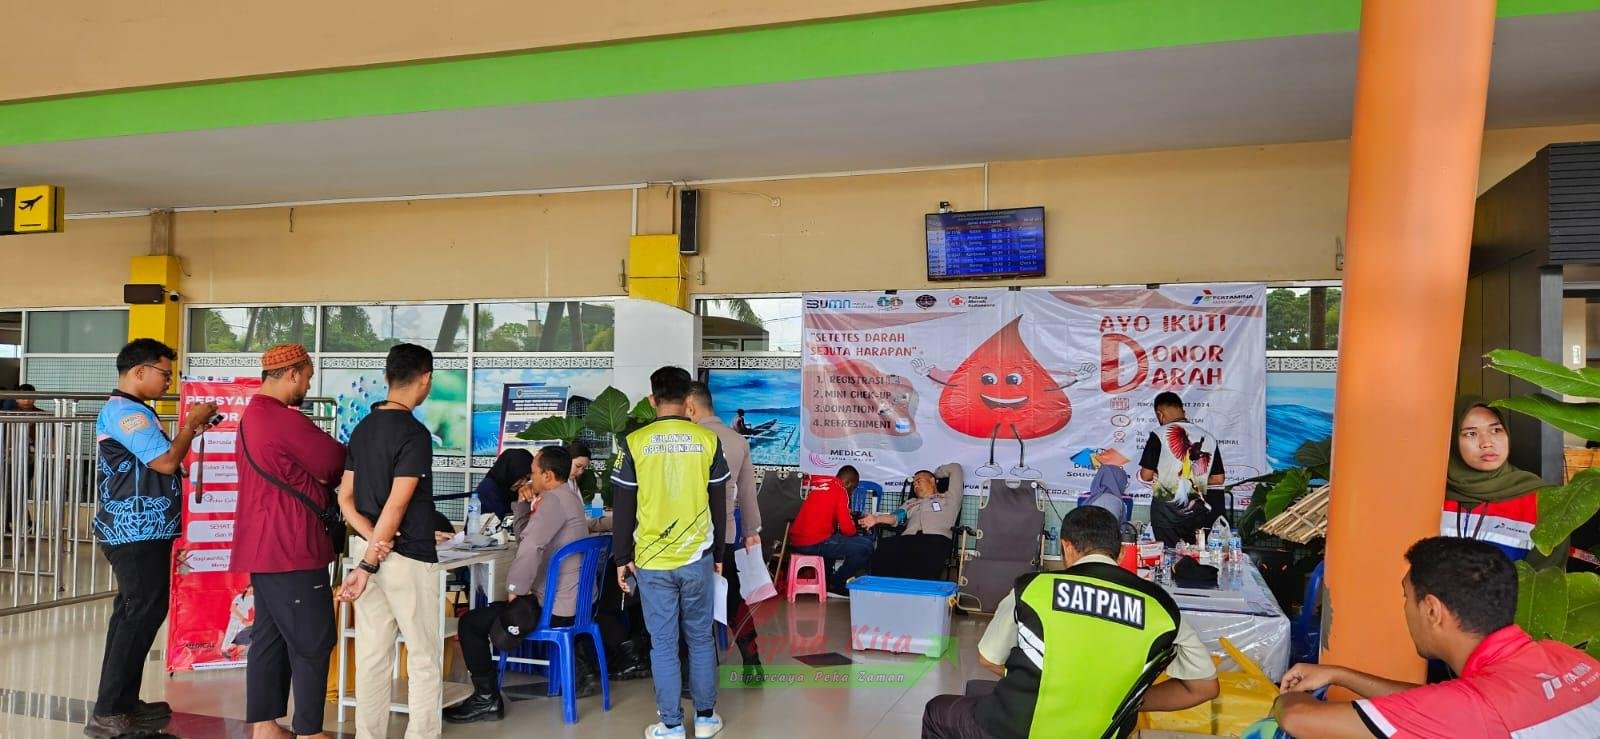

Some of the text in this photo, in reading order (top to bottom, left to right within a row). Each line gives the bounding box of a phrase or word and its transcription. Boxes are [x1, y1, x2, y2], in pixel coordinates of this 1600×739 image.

[806, 299, 851, 309] BUMN
[1099, 314, 1226, 333] AYO IKUTI
[864, 332, 905, 343] DARAH
[810, 346, 851, 356] SEJUTA
[829, 375, 884, 385] REGISTRASI
[825, 390, 847, 399] MINI
[850, 390, 892, 400] CHEK-UP
[824, 419, 892, 429] REFRESHMENT
[830, 449, 874, 458] MEDICAL
[1056, 582, 1143, 625] SATPAM
